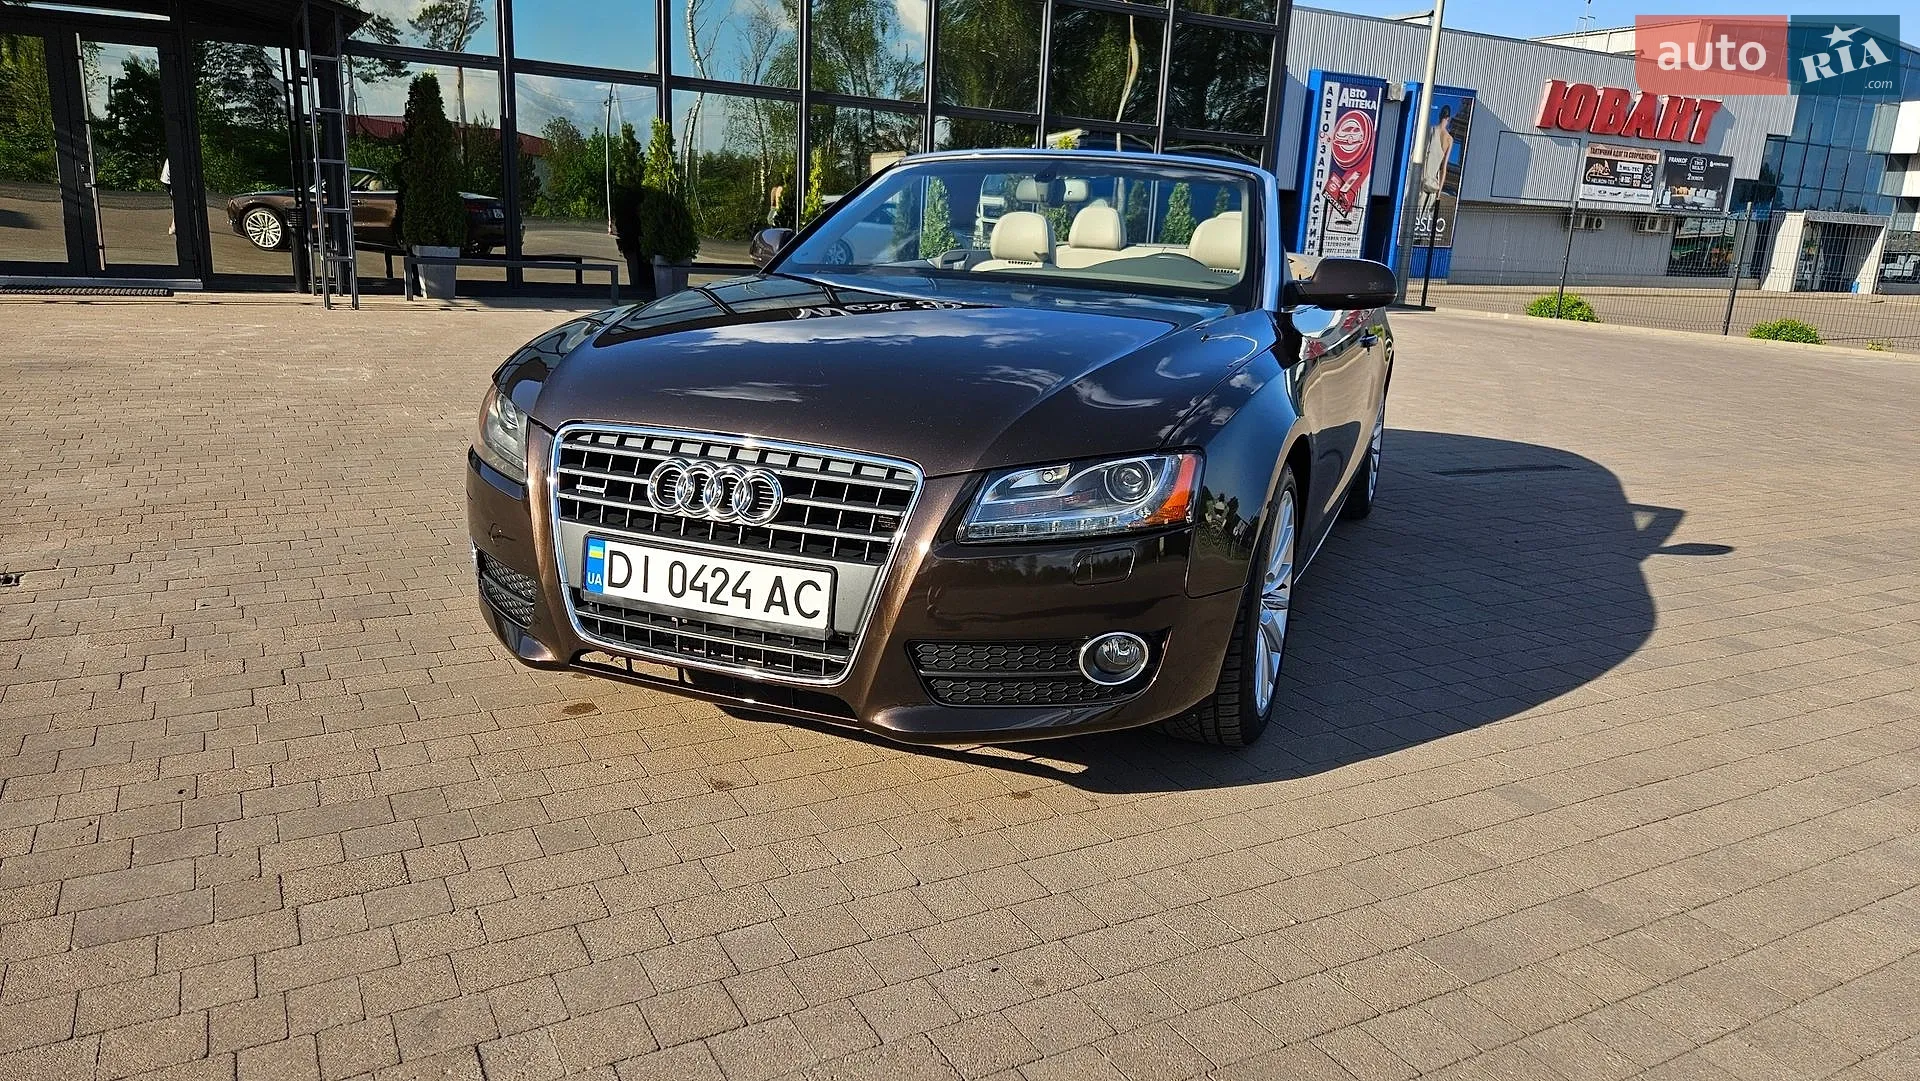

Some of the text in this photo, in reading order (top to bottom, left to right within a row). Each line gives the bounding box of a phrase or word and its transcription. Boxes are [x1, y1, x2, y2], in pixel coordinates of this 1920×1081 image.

[1536, 79, 1722, 144] ЮВАНТ
[587, 572, 603, 585] UA
[607, 550, 822, 619] DI 0424 AC
